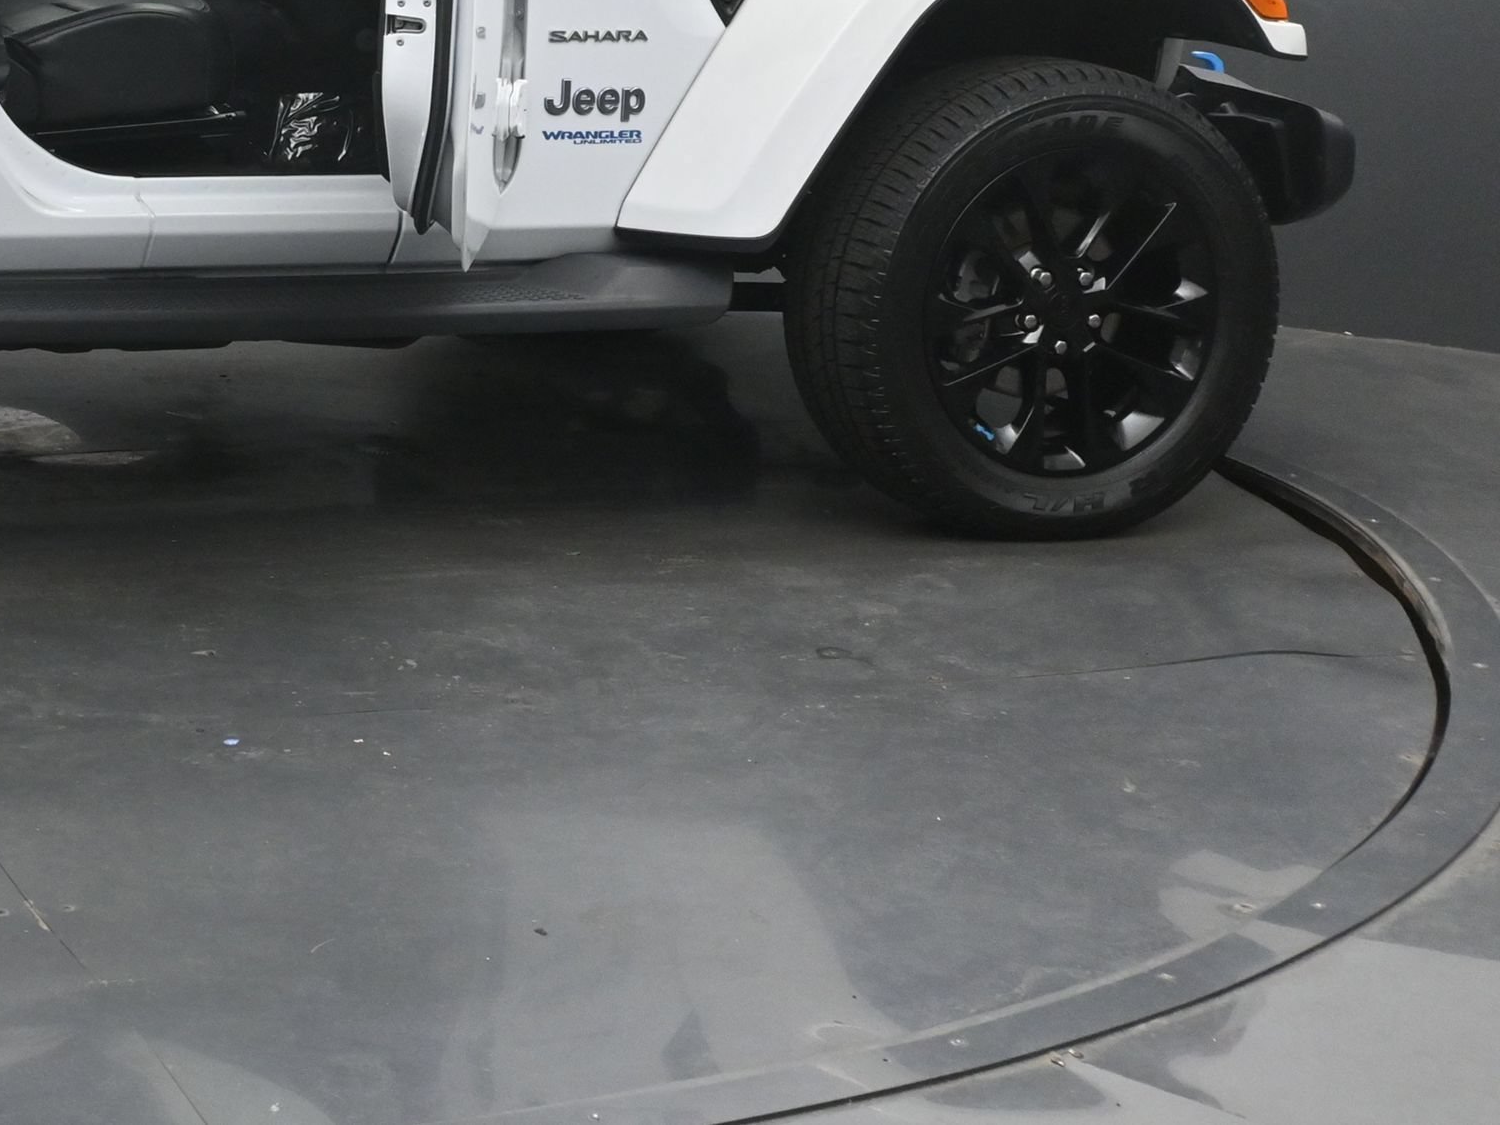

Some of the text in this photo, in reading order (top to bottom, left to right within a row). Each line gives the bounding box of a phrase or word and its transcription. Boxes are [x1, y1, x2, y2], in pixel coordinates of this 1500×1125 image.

[548, 30, 648, 43] SAHARA
[544, 78, 646, 122] Jeep
[542, 130, 642, 140] WRANGLER
